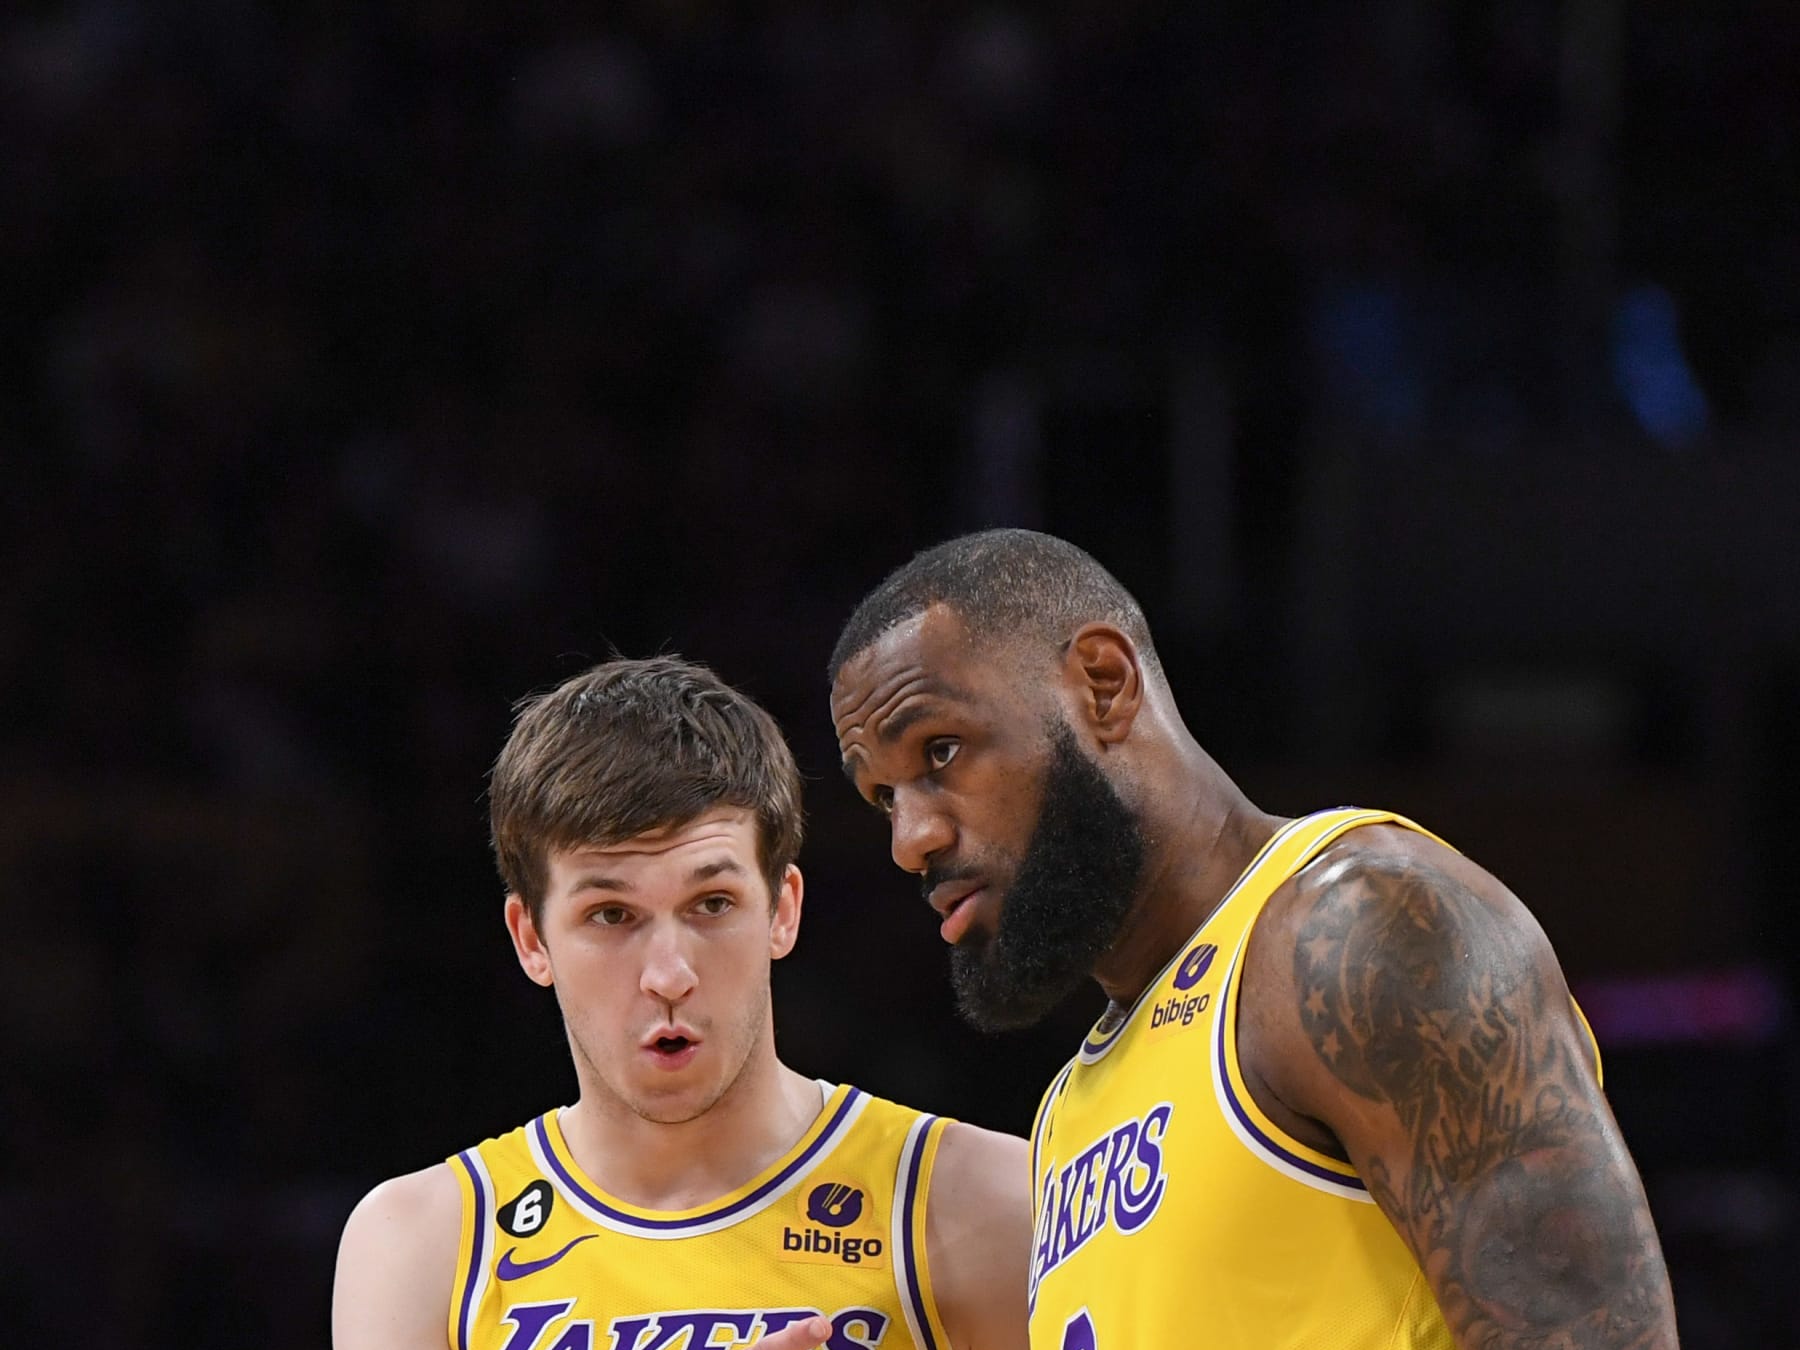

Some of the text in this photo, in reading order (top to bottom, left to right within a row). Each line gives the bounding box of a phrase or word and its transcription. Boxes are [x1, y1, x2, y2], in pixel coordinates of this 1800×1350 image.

[1151, 994, 1210, 1029] bibigo
[511, 1187, 544, 1233] 6
[783, 1227, 882, 1263] bibigo
